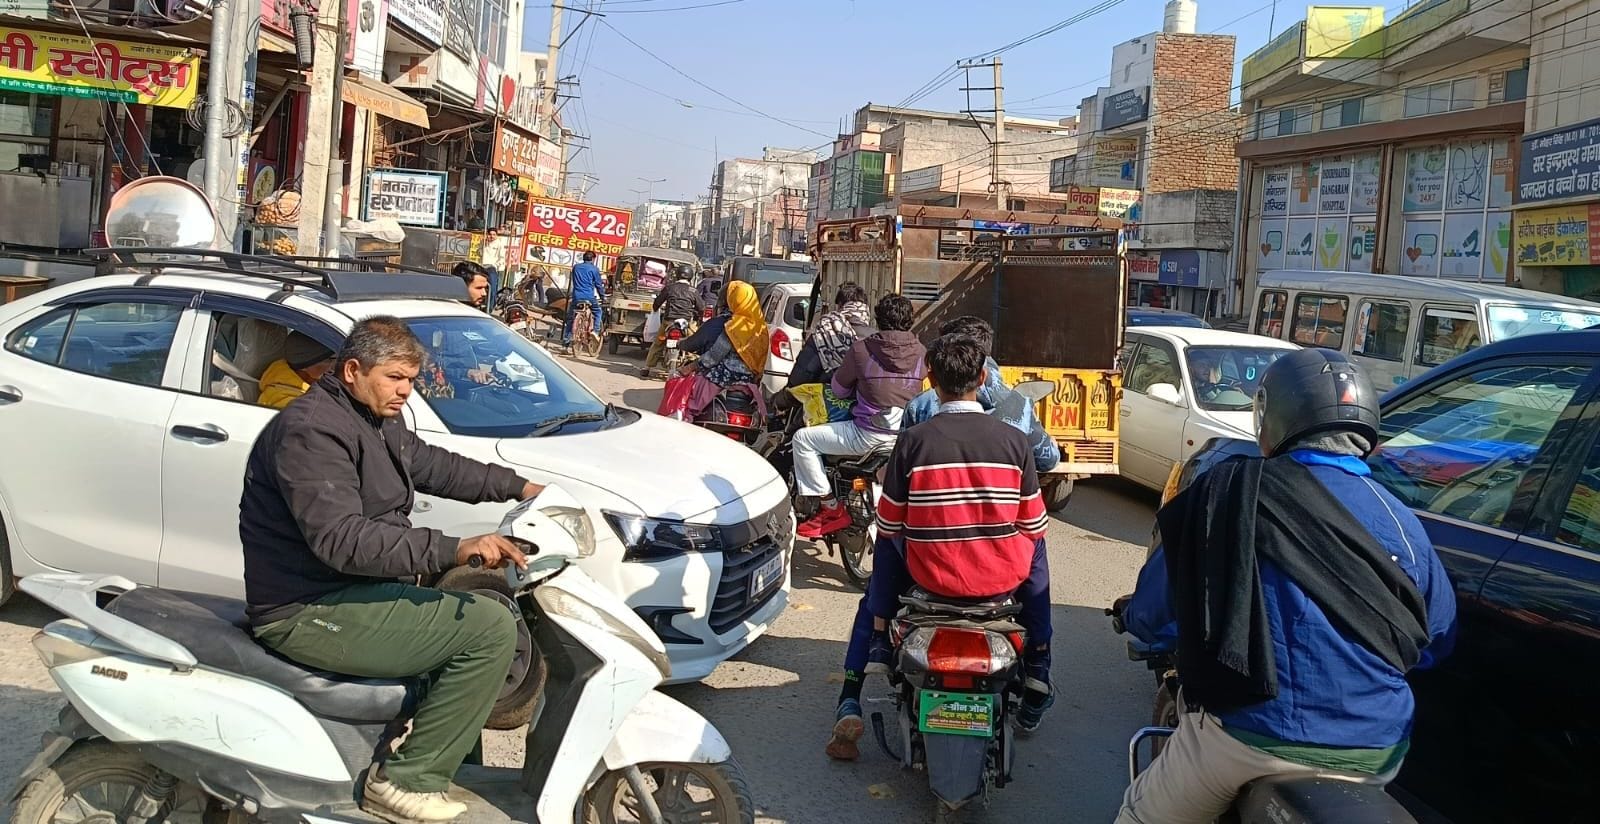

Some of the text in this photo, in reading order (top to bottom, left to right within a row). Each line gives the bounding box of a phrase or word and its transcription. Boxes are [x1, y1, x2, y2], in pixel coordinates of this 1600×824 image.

[48, 43, 191, 97] स्वीट्स
[1428, 184, 1440, 192] you
[1521, 180, 1547, 200] जनरल
[1556, 168, 1578, 194] बच्चों
[1577, 173, 1591, 191] का
[532, 203, 626, 237] कुण्डू 22G
[528, 230, 566, 248] बाईक
[1168, 261, 1178, 272] SBI
[1050, 406, 1078, 427] RN
[90, 665, 128, 681] DACUS
